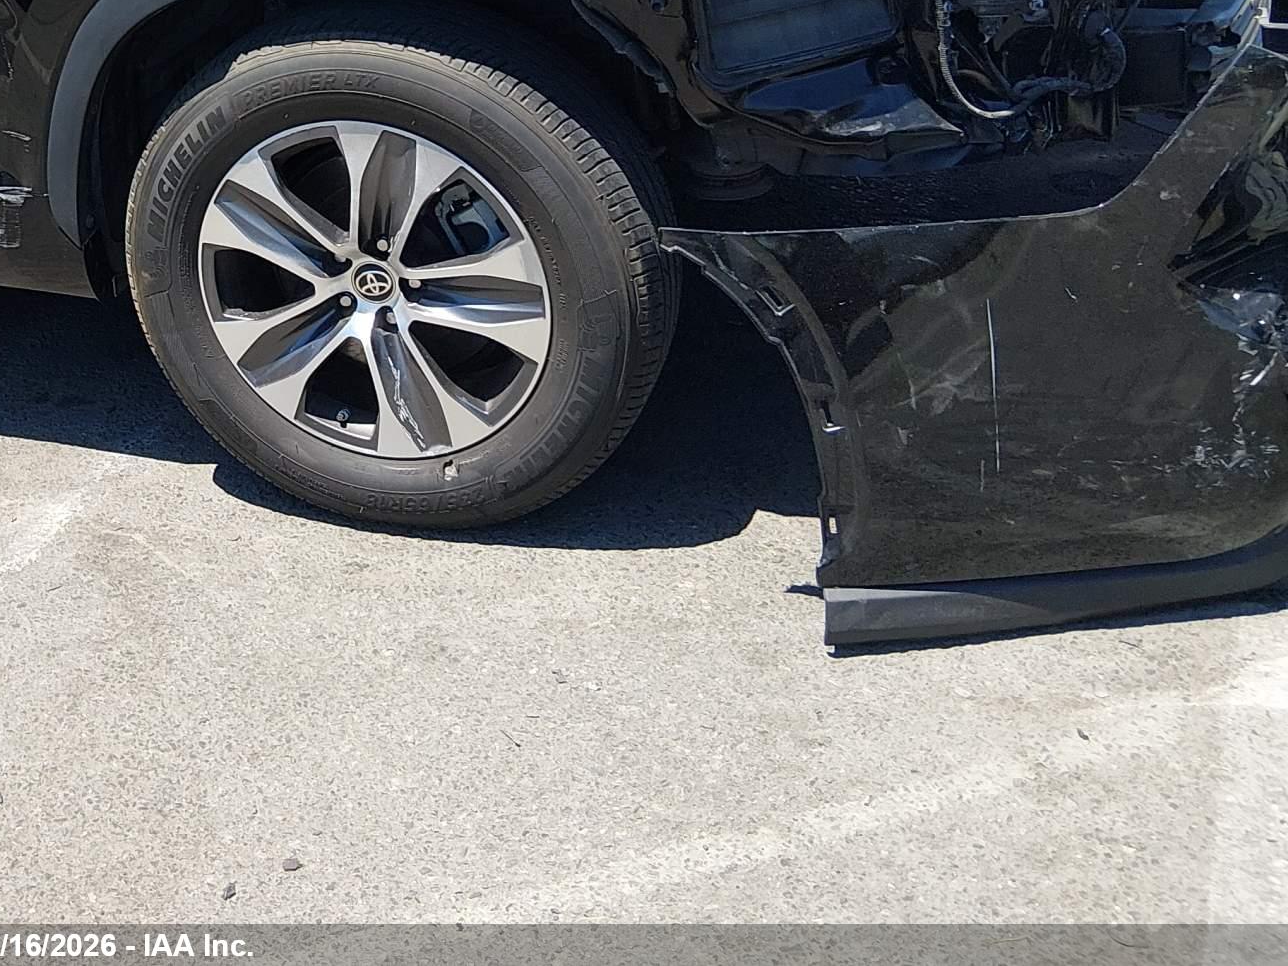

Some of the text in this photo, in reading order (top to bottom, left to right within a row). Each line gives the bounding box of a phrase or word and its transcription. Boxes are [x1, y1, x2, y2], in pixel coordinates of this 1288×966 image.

[240, 71, 381, 107] PREMIER LTX
[146, 105, 229, 242] MICHELIN
